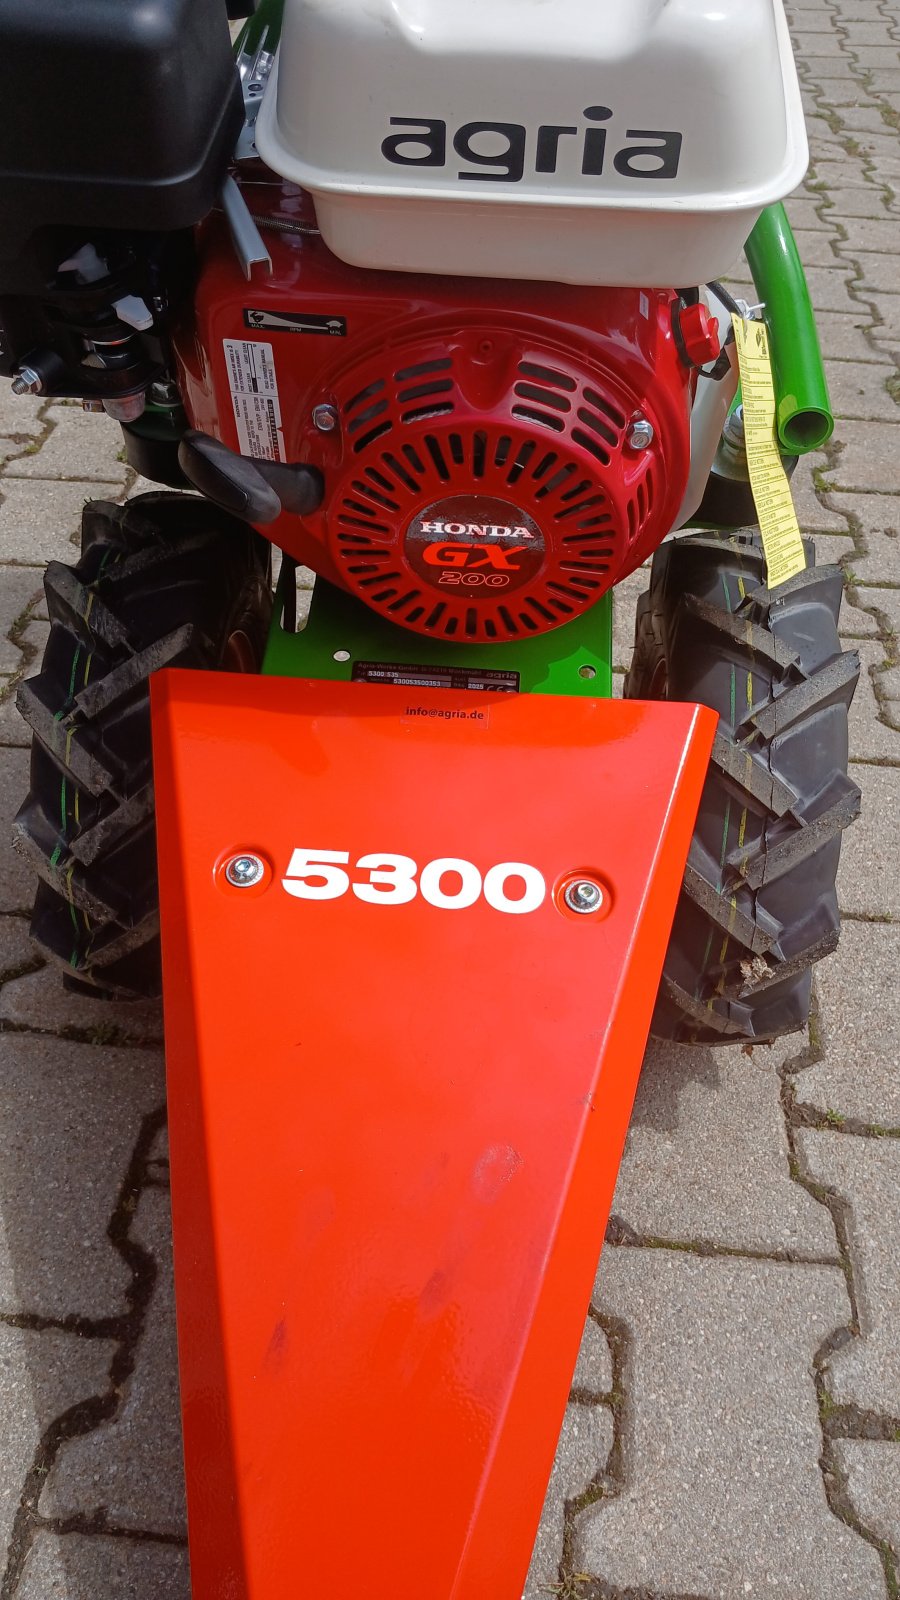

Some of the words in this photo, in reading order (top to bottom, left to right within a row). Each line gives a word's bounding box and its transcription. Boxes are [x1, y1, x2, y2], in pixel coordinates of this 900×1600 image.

[380, 105, 682, 183] agria
[420, 521, 535, 538] HONDA
[422, 541, 528, 570] GX
[438, 571, 510, 587] 200
[486, 671, 517, 680] agria
[406, 706, 484, 720] info@agria.de
[281, 847, 546, 914] 5300
